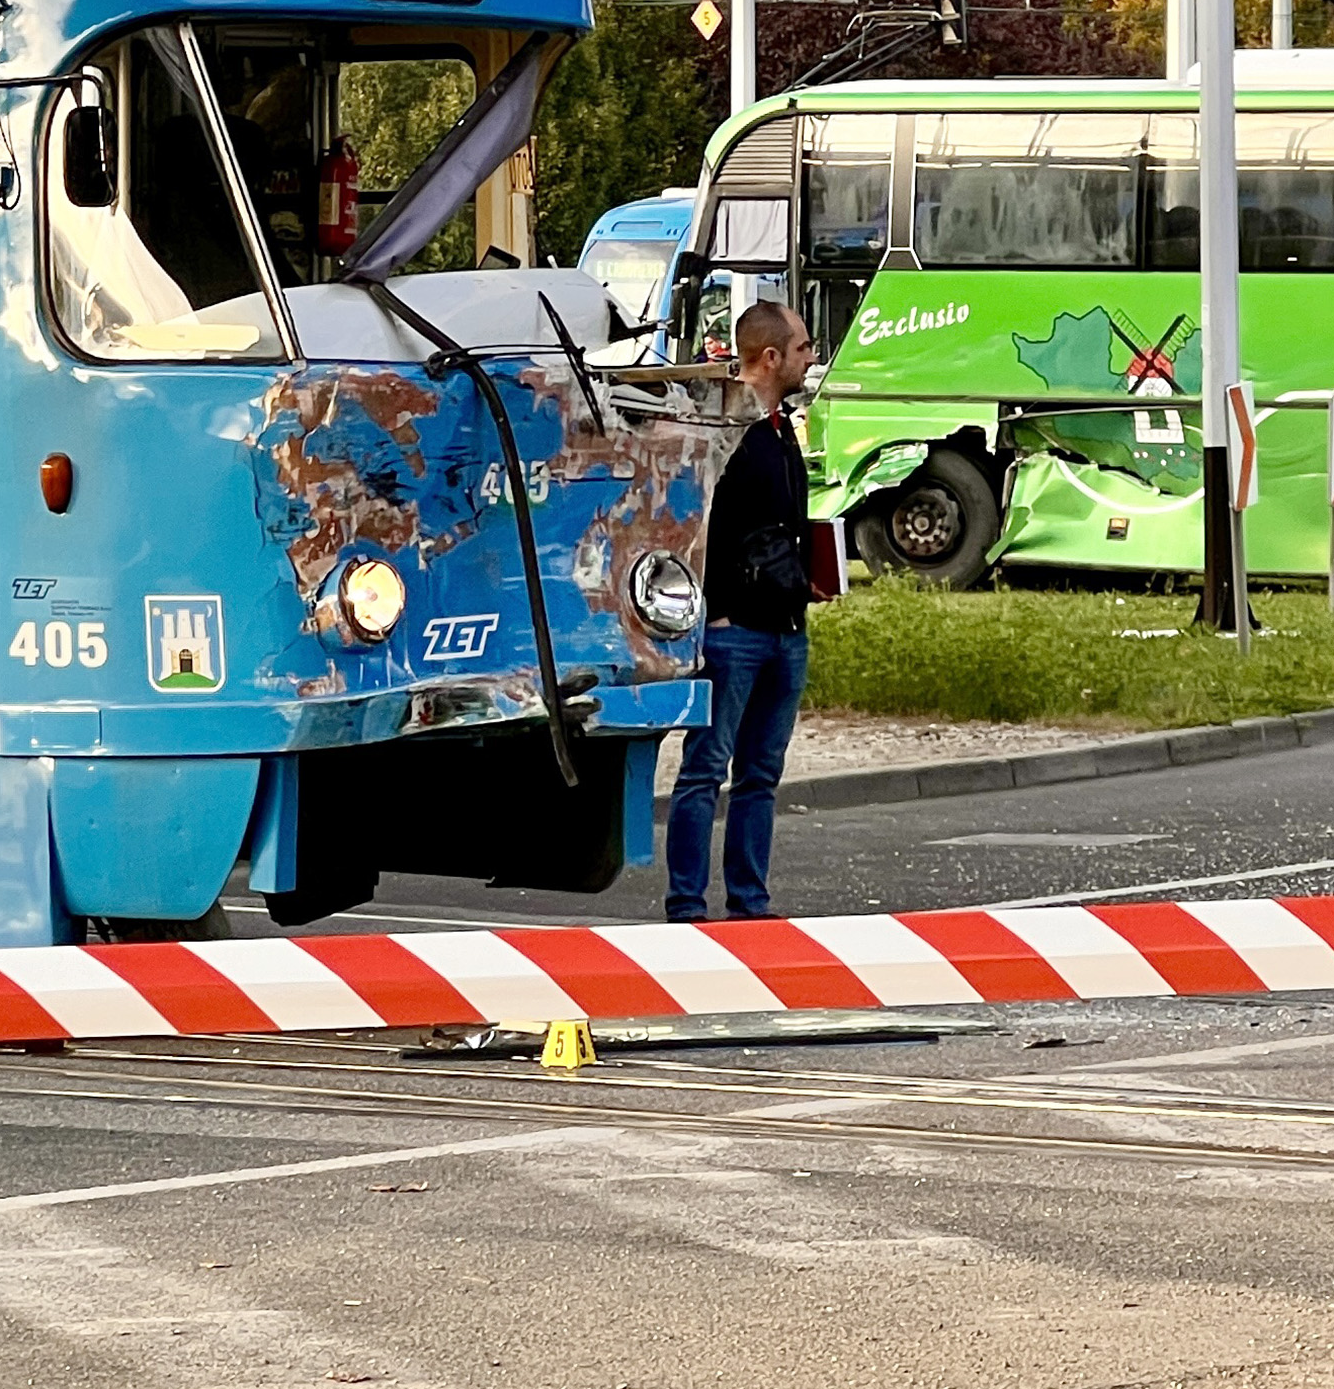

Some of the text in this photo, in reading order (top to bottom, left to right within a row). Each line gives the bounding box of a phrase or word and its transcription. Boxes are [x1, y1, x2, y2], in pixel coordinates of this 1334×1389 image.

[703, 11, 711, 26] 5
[12, 578, 58, 600] ZET
[9, 621, 108, 668] 405
[423, 613, 499, 661] ZET
[555, 1030, 565, 1058] 5
